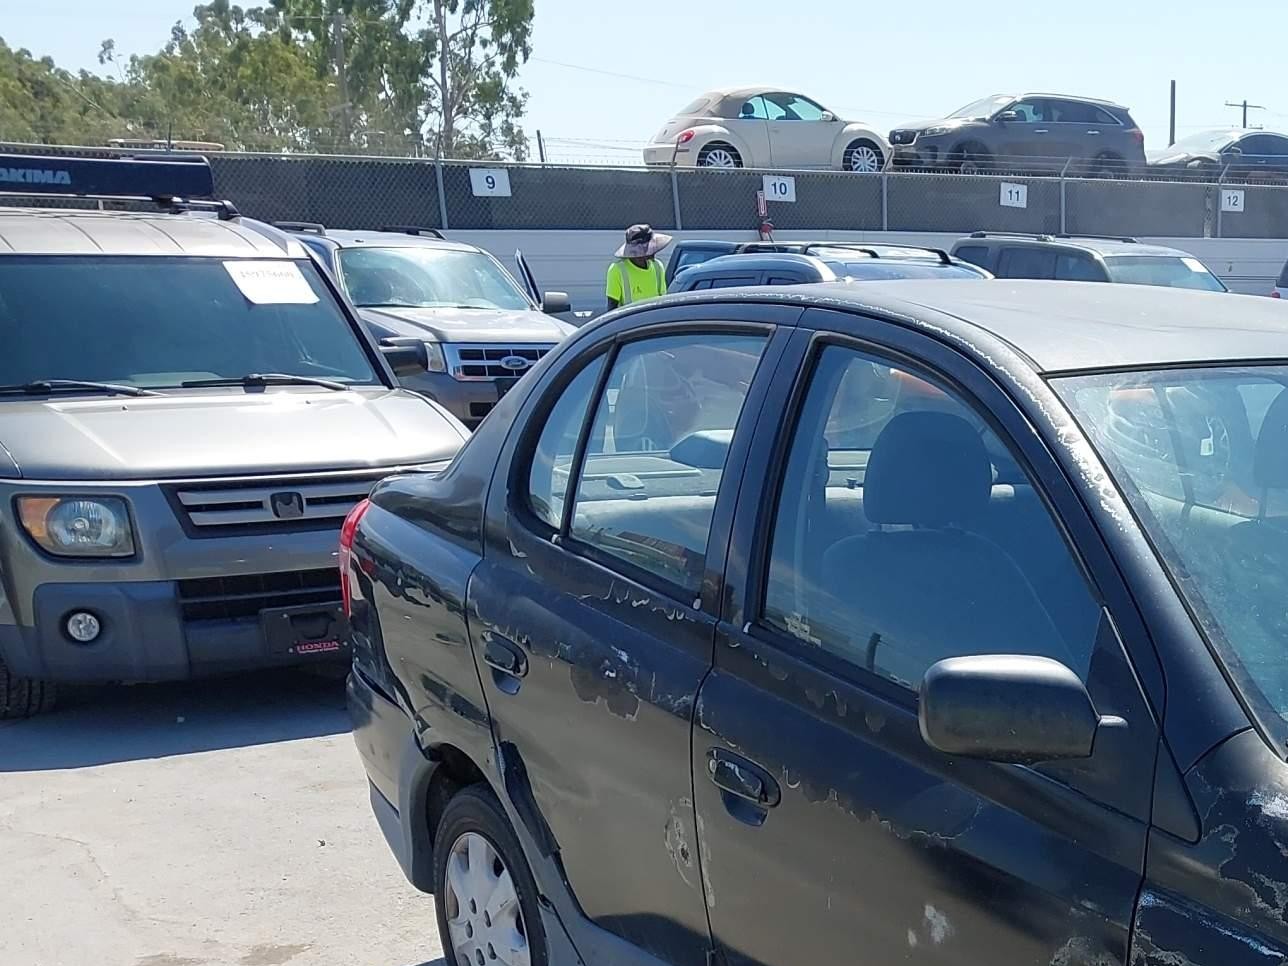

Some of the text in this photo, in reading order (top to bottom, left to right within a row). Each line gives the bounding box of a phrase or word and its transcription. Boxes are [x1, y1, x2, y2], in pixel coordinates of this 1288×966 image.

[485, 175, 496, 189] 9
[771, 182, 788, 195] 10
[1008, 190, 1020, 201] 11
[1227, 195, 1239, 206] 12
